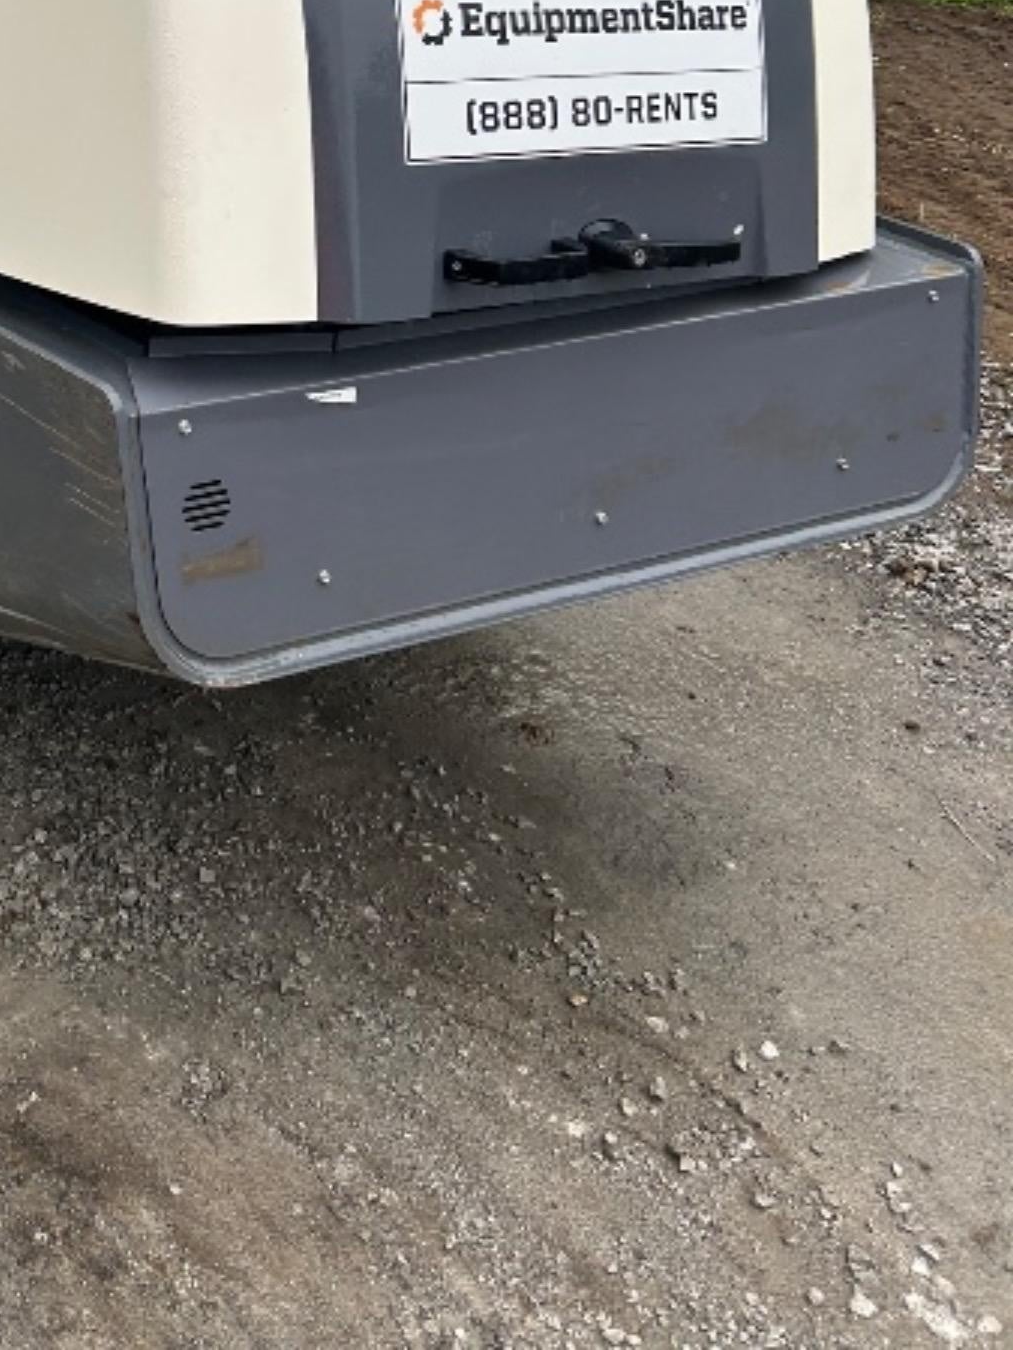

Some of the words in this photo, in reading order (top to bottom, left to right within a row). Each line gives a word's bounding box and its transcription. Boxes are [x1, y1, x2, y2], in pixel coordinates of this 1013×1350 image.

[458, 0, 747, 45] EquipmentShare
[466, 95, 559, 135] (888)
[571, 92, 718, 127] 80-RENTS
